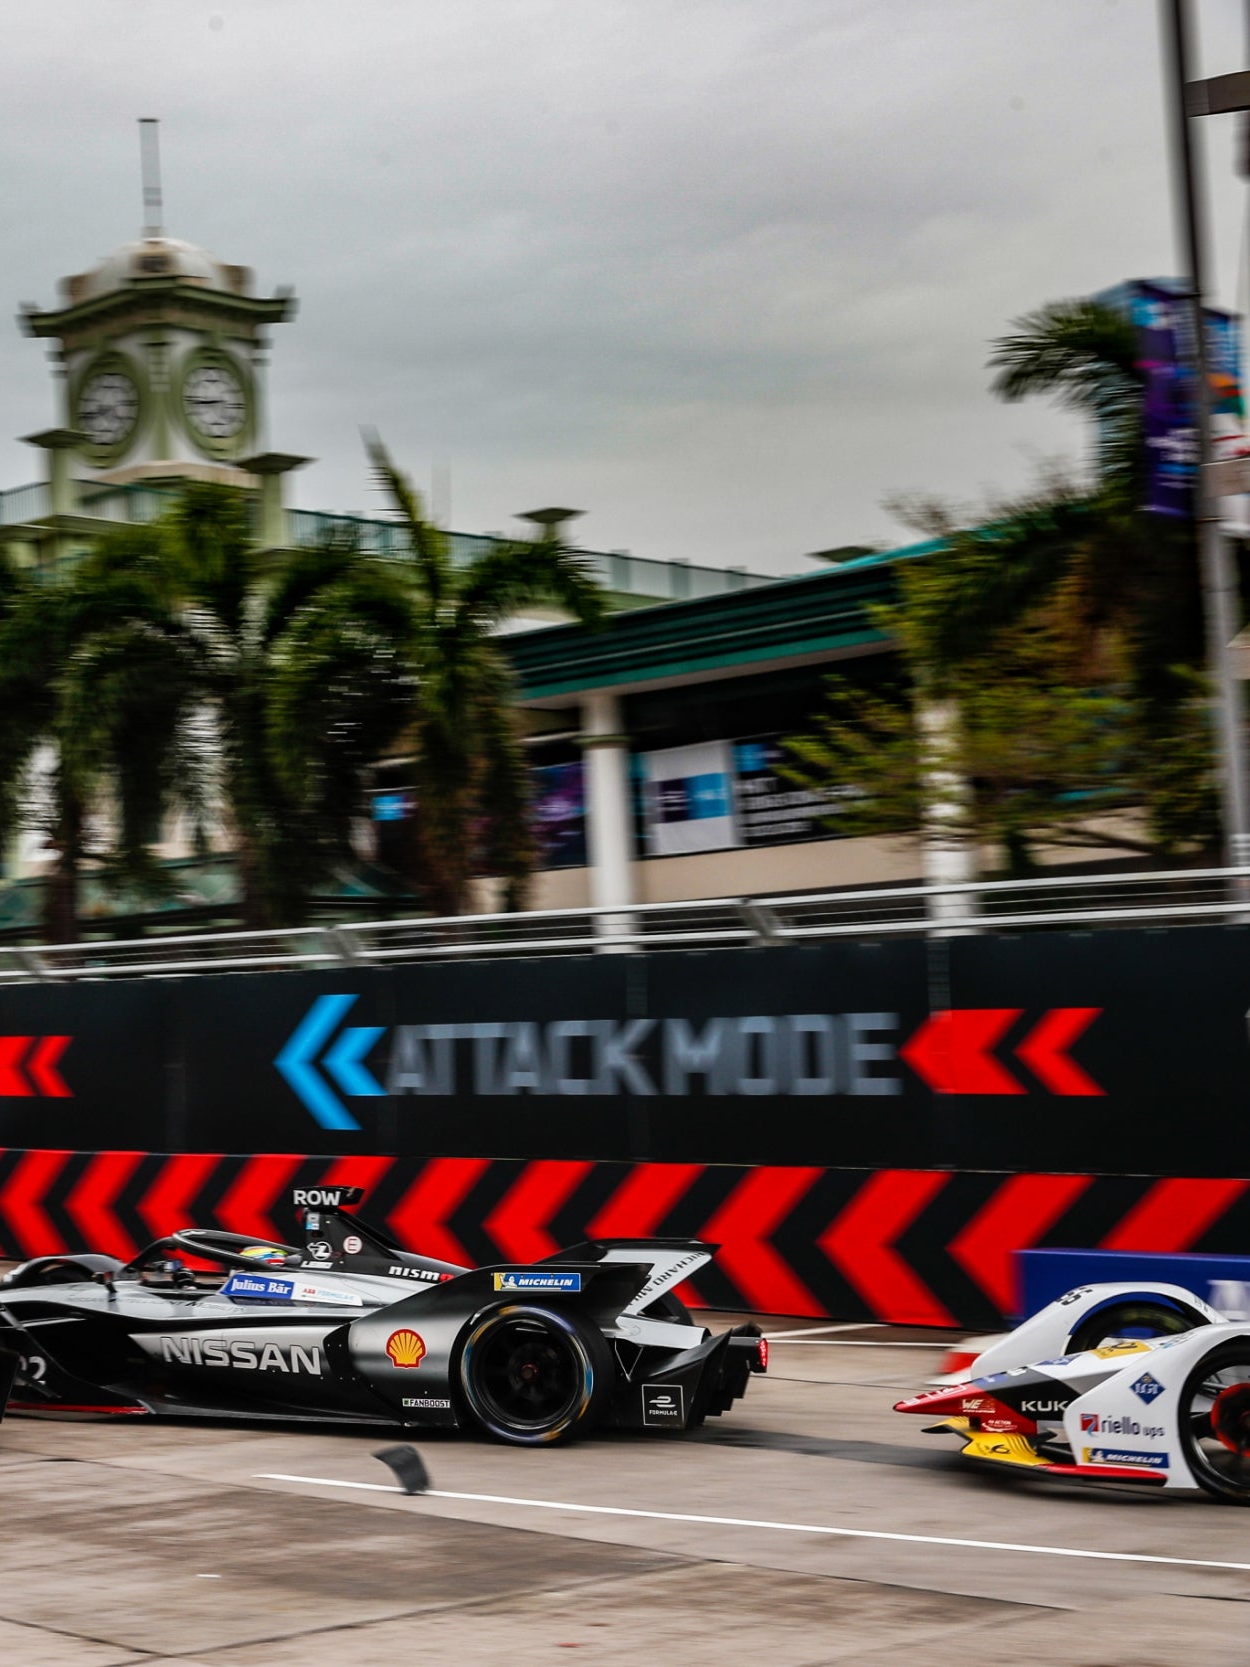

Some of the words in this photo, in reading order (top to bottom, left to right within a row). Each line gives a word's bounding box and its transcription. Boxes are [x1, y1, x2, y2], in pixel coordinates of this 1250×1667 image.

[388, 1018, 659, 1097] ATTACK
[662, 1012, 902, 1097] MODE
[293, 1189, 341, 1206] ROW
[231, 1278, 267, 1292] Julius
[267, 1280, 291, 1295] Bär
[518, 1278, 574, 1287] MICHELIN
[160, 1336, 322, 1376] NISSAN
[409, 1400, 450, 1408] FANBOOST
[1021, 1400, 1069, 1412] KUK
[1101, 1415, 1141, 1436] riello
[1143, 1425, 1165, 1438] ups
[1106, 1453, 1164, 1465] MICHELIN
